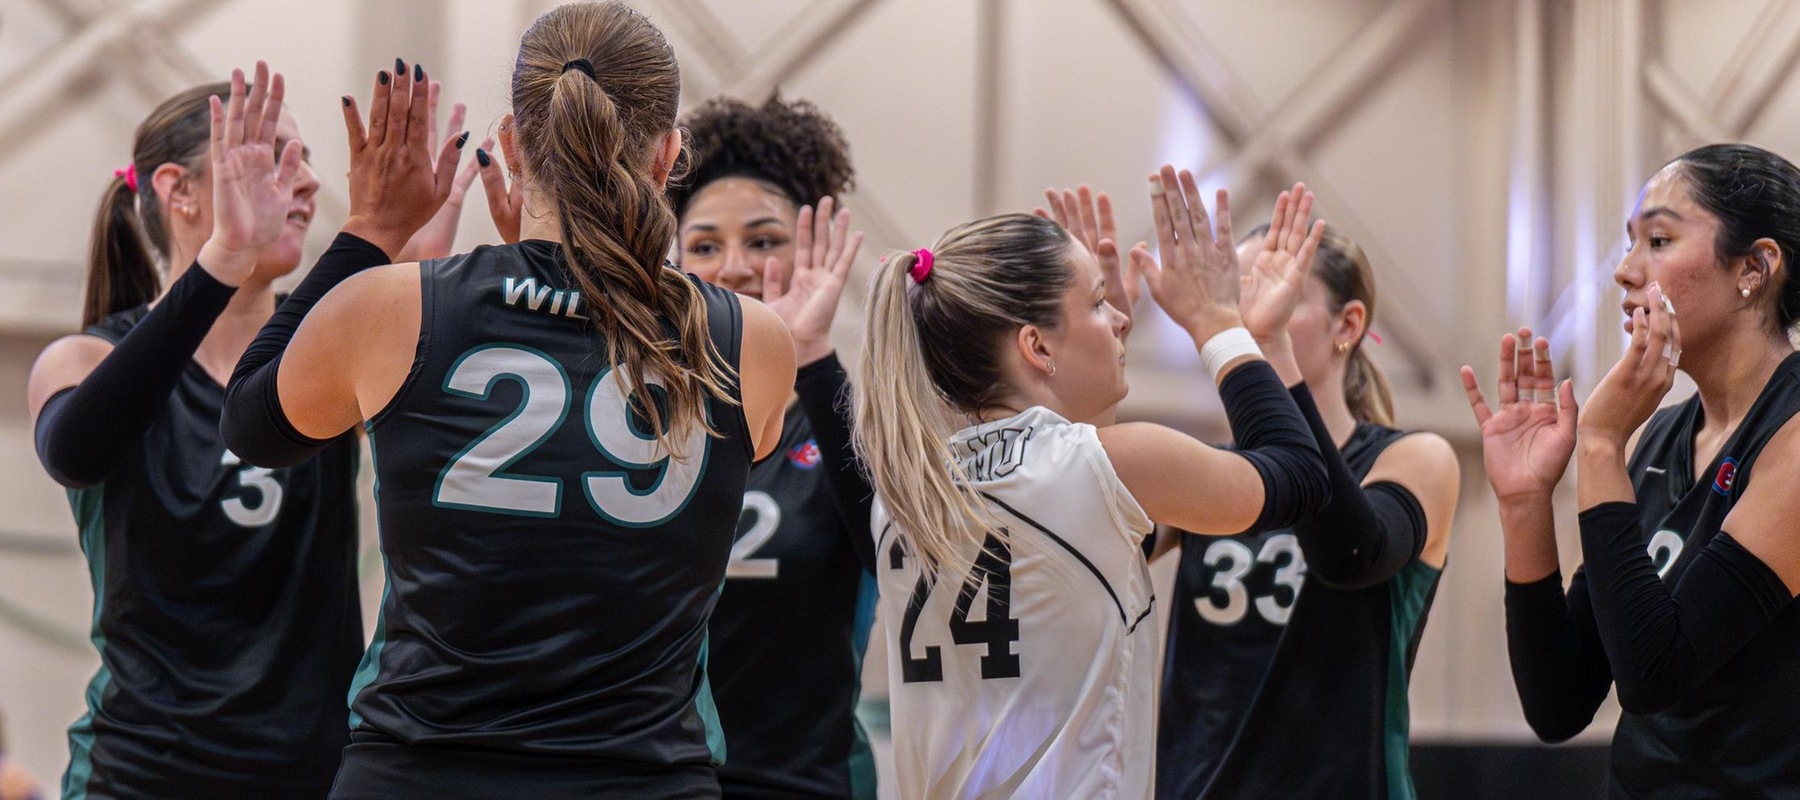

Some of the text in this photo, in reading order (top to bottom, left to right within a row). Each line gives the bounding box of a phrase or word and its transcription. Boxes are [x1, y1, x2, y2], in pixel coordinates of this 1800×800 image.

[221, 448, 283, 527] 3
[433, 342, 712, 528] 29
[889, 525, 1020, 683] 24
[1194, 533, 1308, 626] 33
